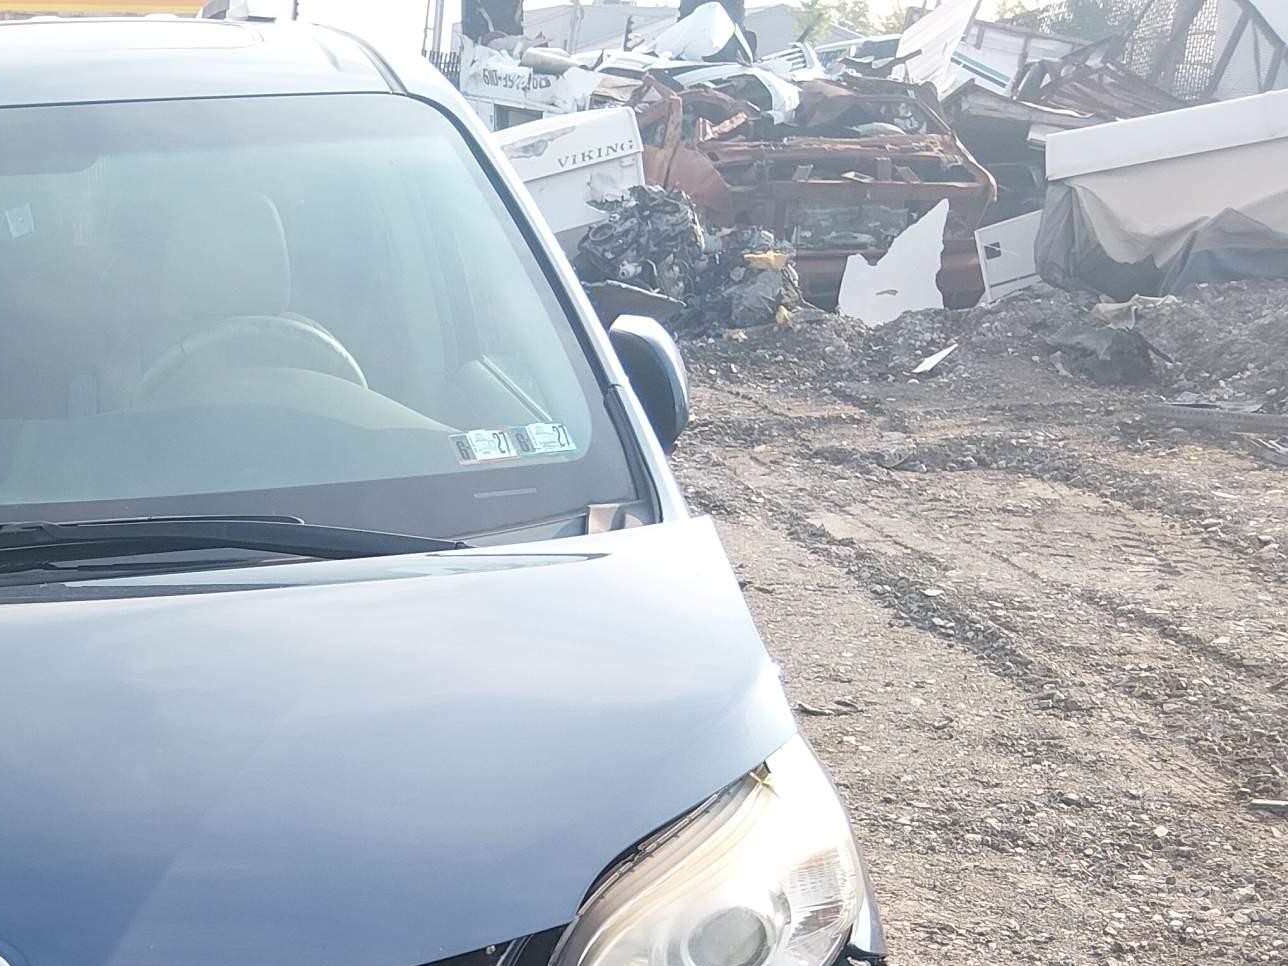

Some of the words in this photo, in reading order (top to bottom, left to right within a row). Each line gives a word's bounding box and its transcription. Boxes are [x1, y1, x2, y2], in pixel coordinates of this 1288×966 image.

[557, 139, 633, 168] VIKING
[493, 431, 510, 454] 27
[552, 425, 570, 447] 27
